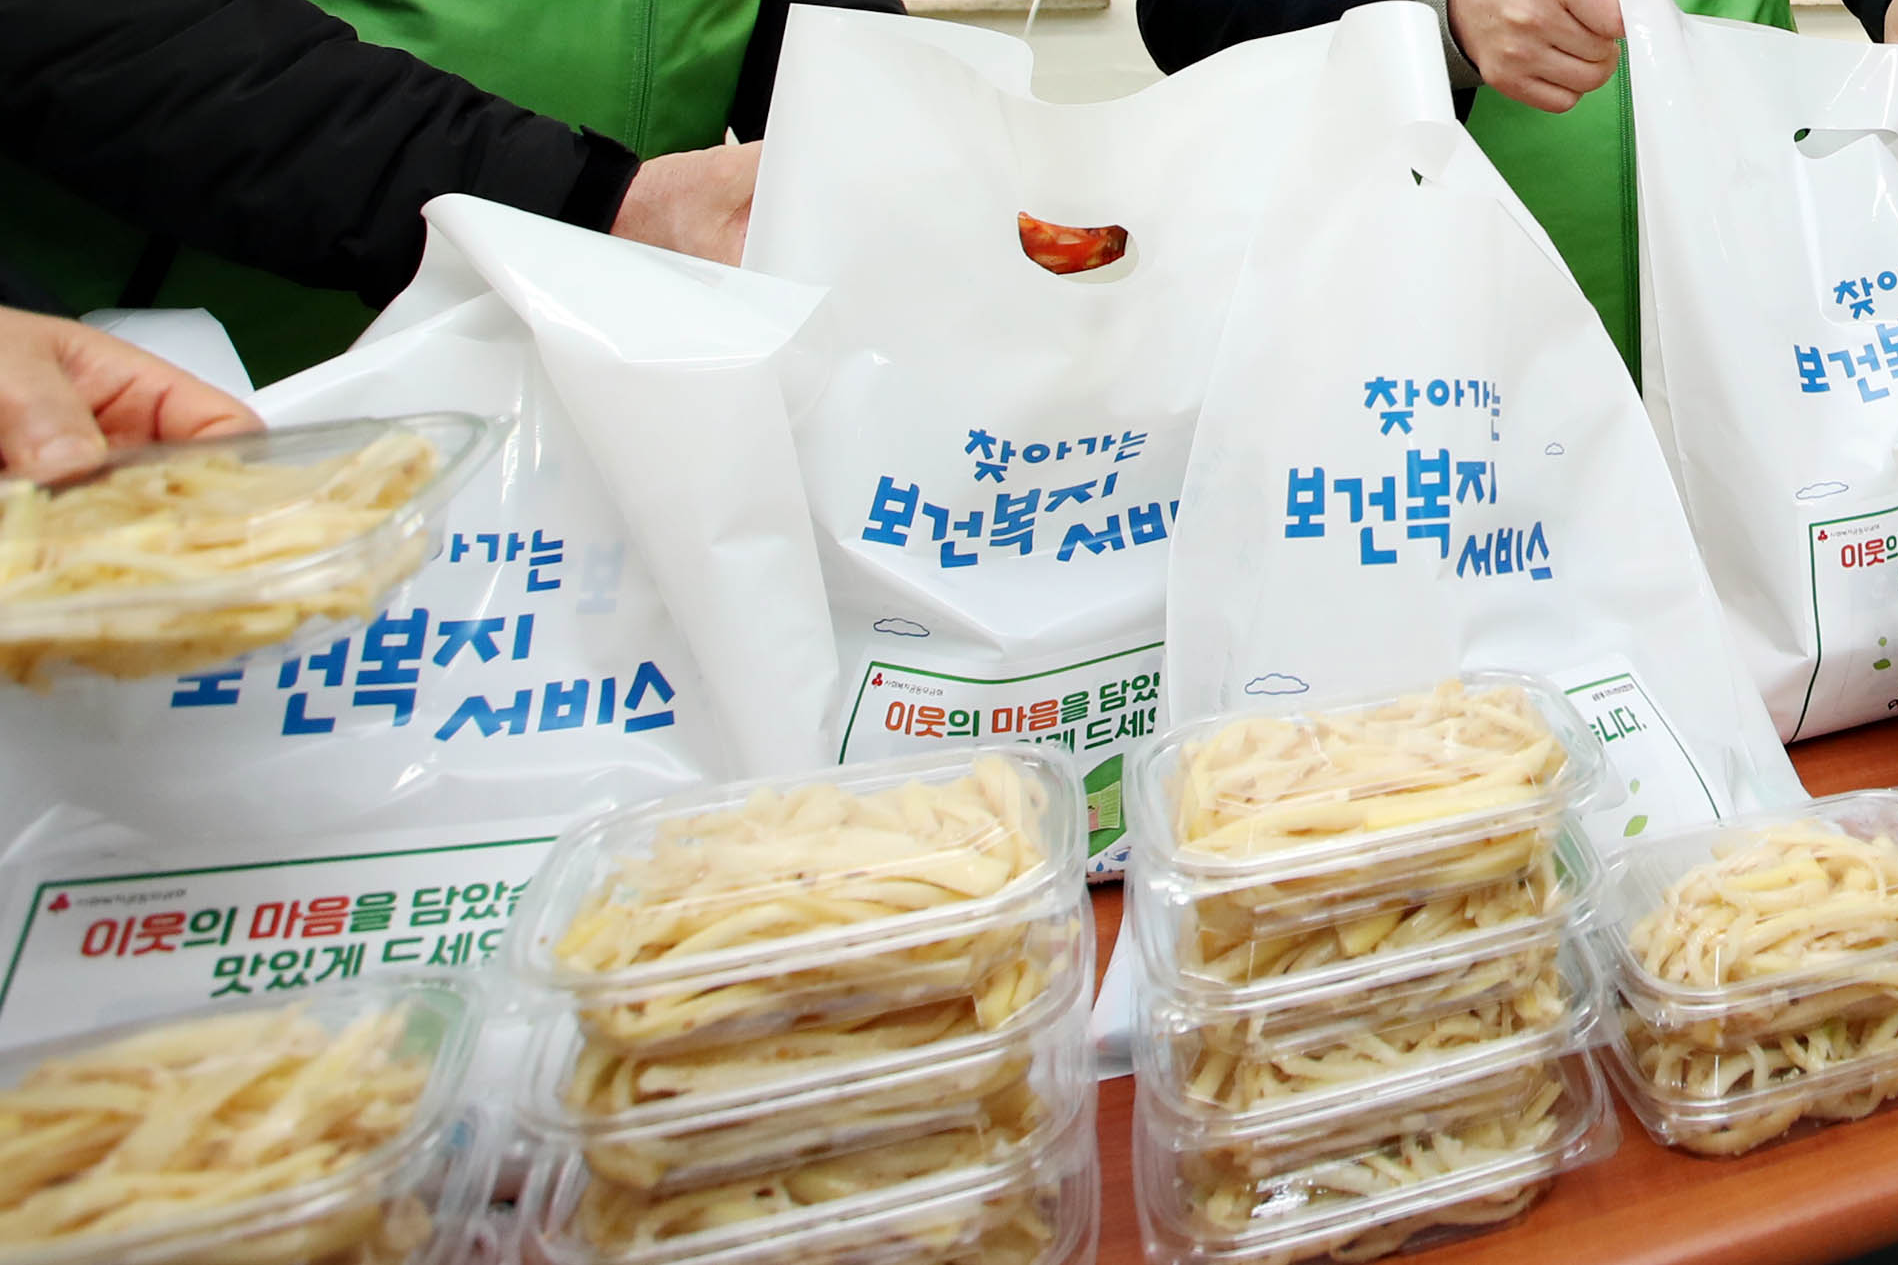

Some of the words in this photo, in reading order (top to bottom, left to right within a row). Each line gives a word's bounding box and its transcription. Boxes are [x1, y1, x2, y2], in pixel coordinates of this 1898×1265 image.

[964, 428, 1149, 484] 찾아가는
[861, 470, 1119, 569] 보건복지
[1284, 447, 1498, 566] 보건복지
[1456, 520, 1553, 581] 서비스
[434, 660, 676, 742] 서비스
[884, 700, 980, 738] 이웃의
[991, 690, 1090, 734] 마음을
[80, 906, 237, 958] 이웃의
[248, 890, 398, 942] 마음을
[210, 943, 366, 999] 맛있게
